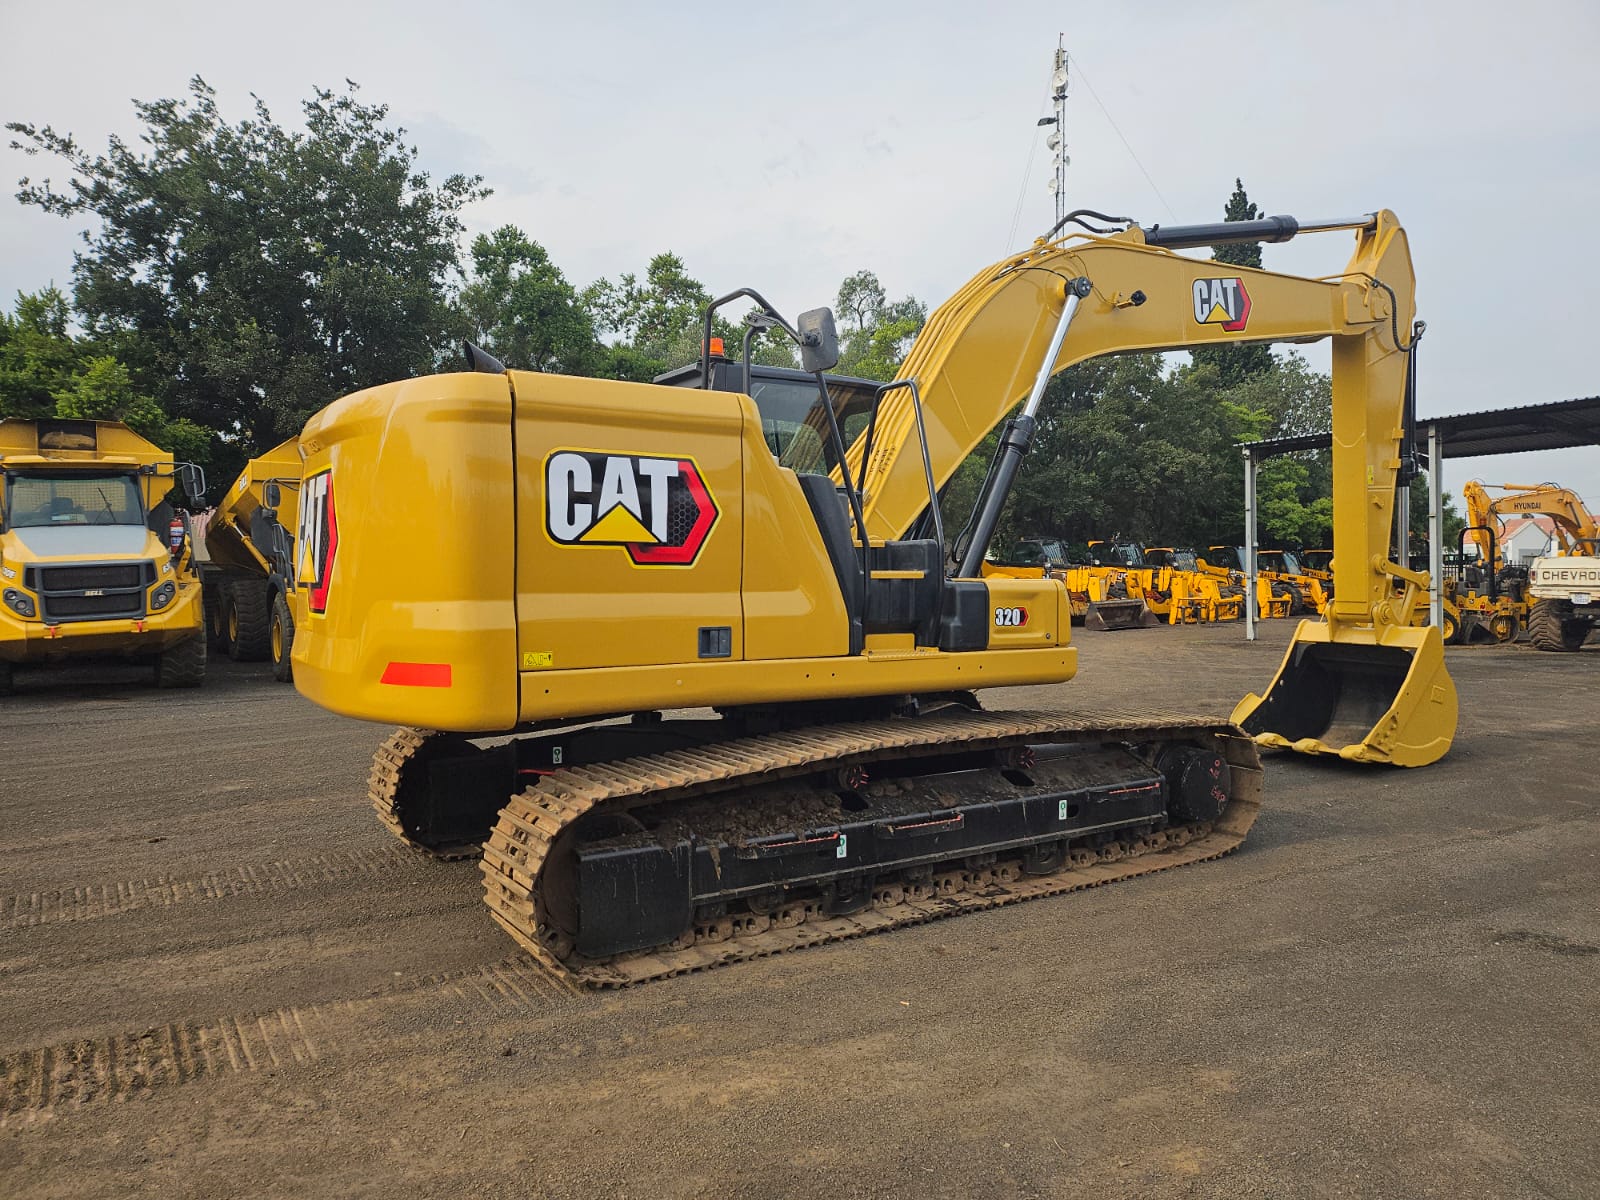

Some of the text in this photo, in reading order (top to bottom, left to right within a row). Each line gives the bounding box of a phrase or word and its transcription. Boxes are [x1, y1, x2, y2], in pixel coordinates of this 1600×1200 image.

[1193, 279, 1236, 323] CAT
[548, 453, 679, 543] CAT
[1514, 502, 1541, 510] HYUNDAI
[995, 608, 1021, 626] 320
